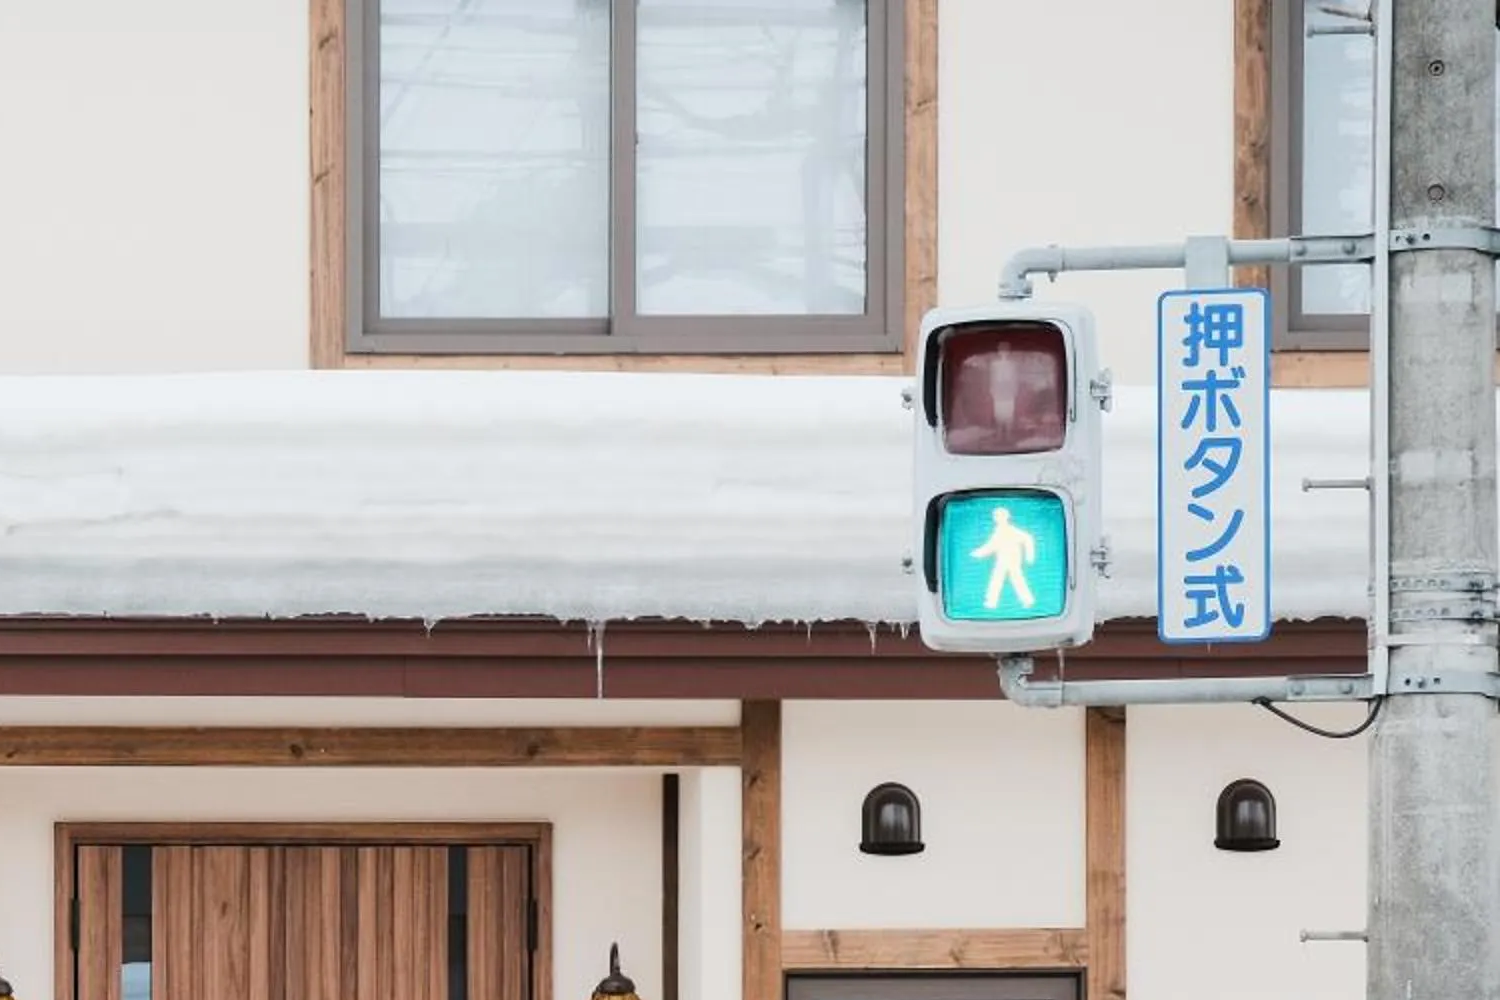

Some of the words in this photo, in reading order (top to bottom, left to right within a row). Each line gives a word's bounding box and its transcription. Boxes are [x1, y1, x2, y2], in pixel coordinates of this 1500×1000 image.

[1182, 302, 1246, 628] 押ボタン式
